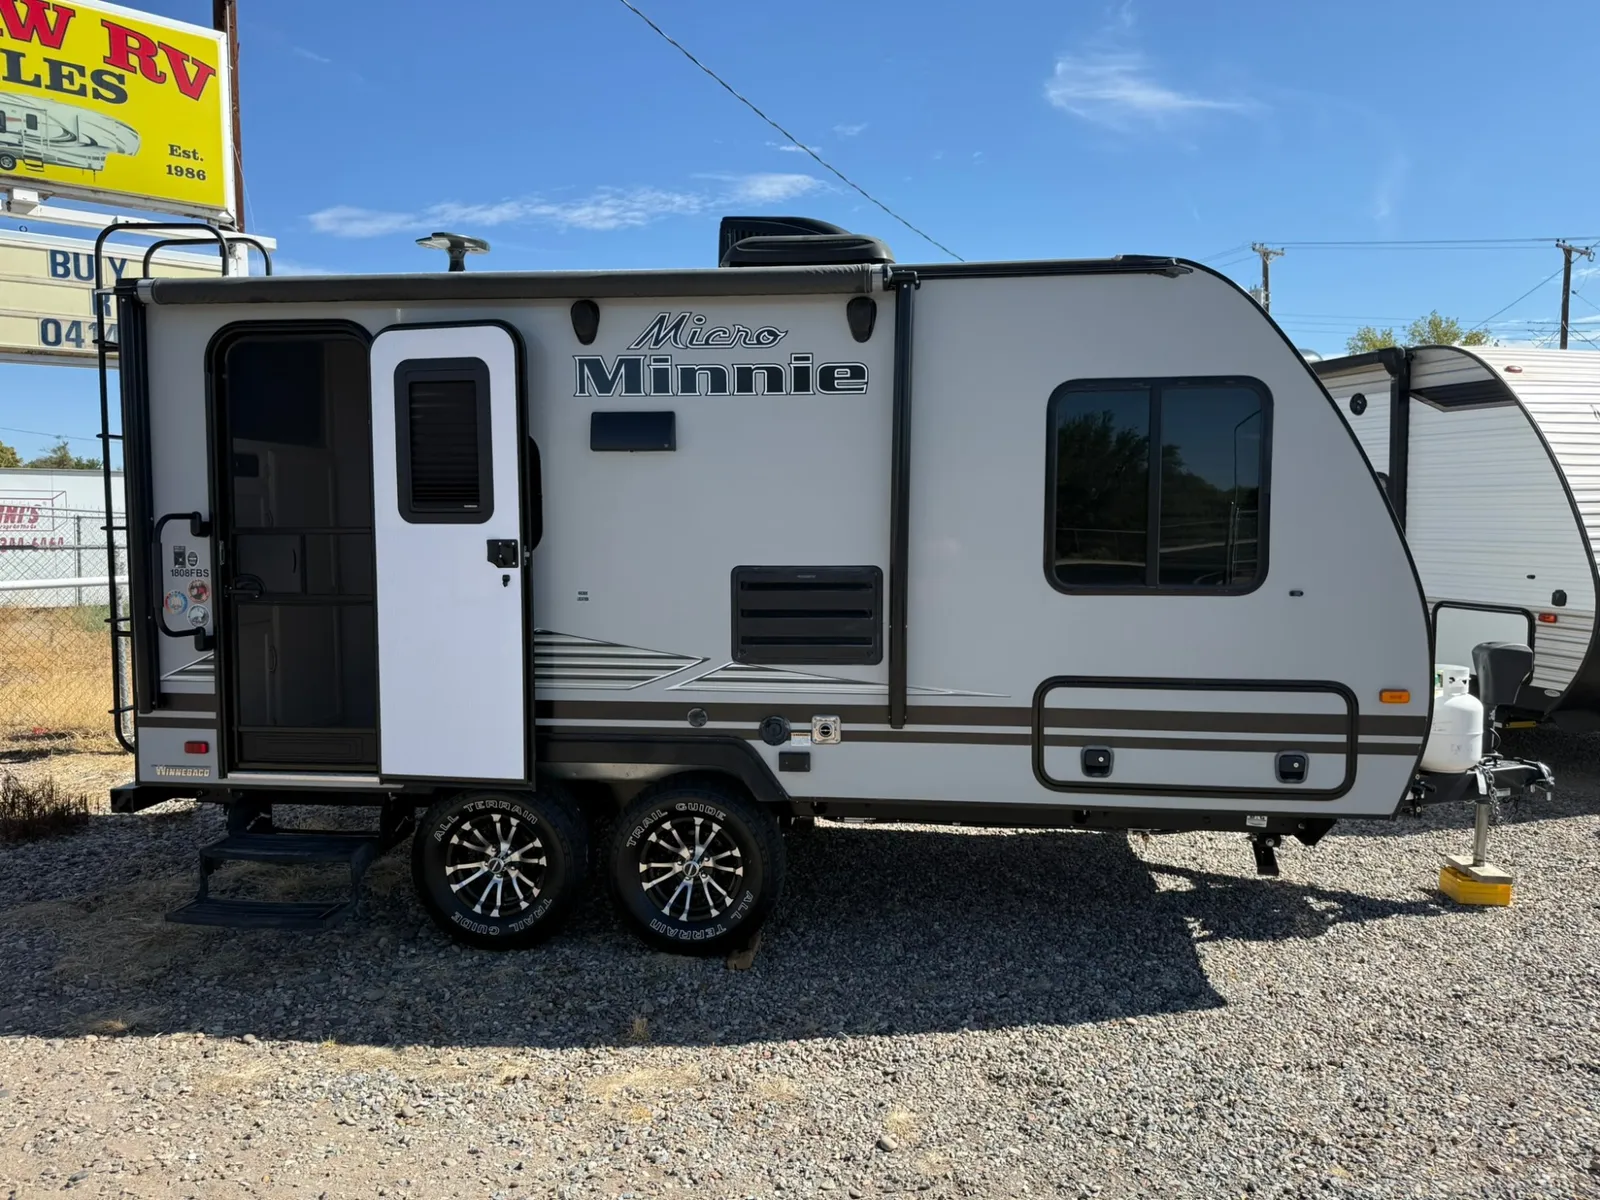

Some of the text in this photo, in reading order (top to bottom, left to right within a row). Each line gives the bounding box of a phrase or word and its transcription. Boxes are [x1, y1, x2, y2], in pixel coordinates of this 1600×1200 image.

[0, 0, 216, 101] W RV
[0, 48, 128, 104] LES
[165, 164, 207, 181] 1986
[168, 144, 204, 162] Est.
[50, 250, 127, 281] BUY
[626, 311, 788, 350] Micro
[572, 352, 869, 397] Minnie
[170, 569, 209, 577] 1808FBS
[433, 800, 538, 842] ALL TERRAIN
[626, 802, 727, 848] TRAIL GUIDE
[451, 898, 553, 936] TRAIL GUIDE
[650, 890, 754, 940] ALL TERRAIN
